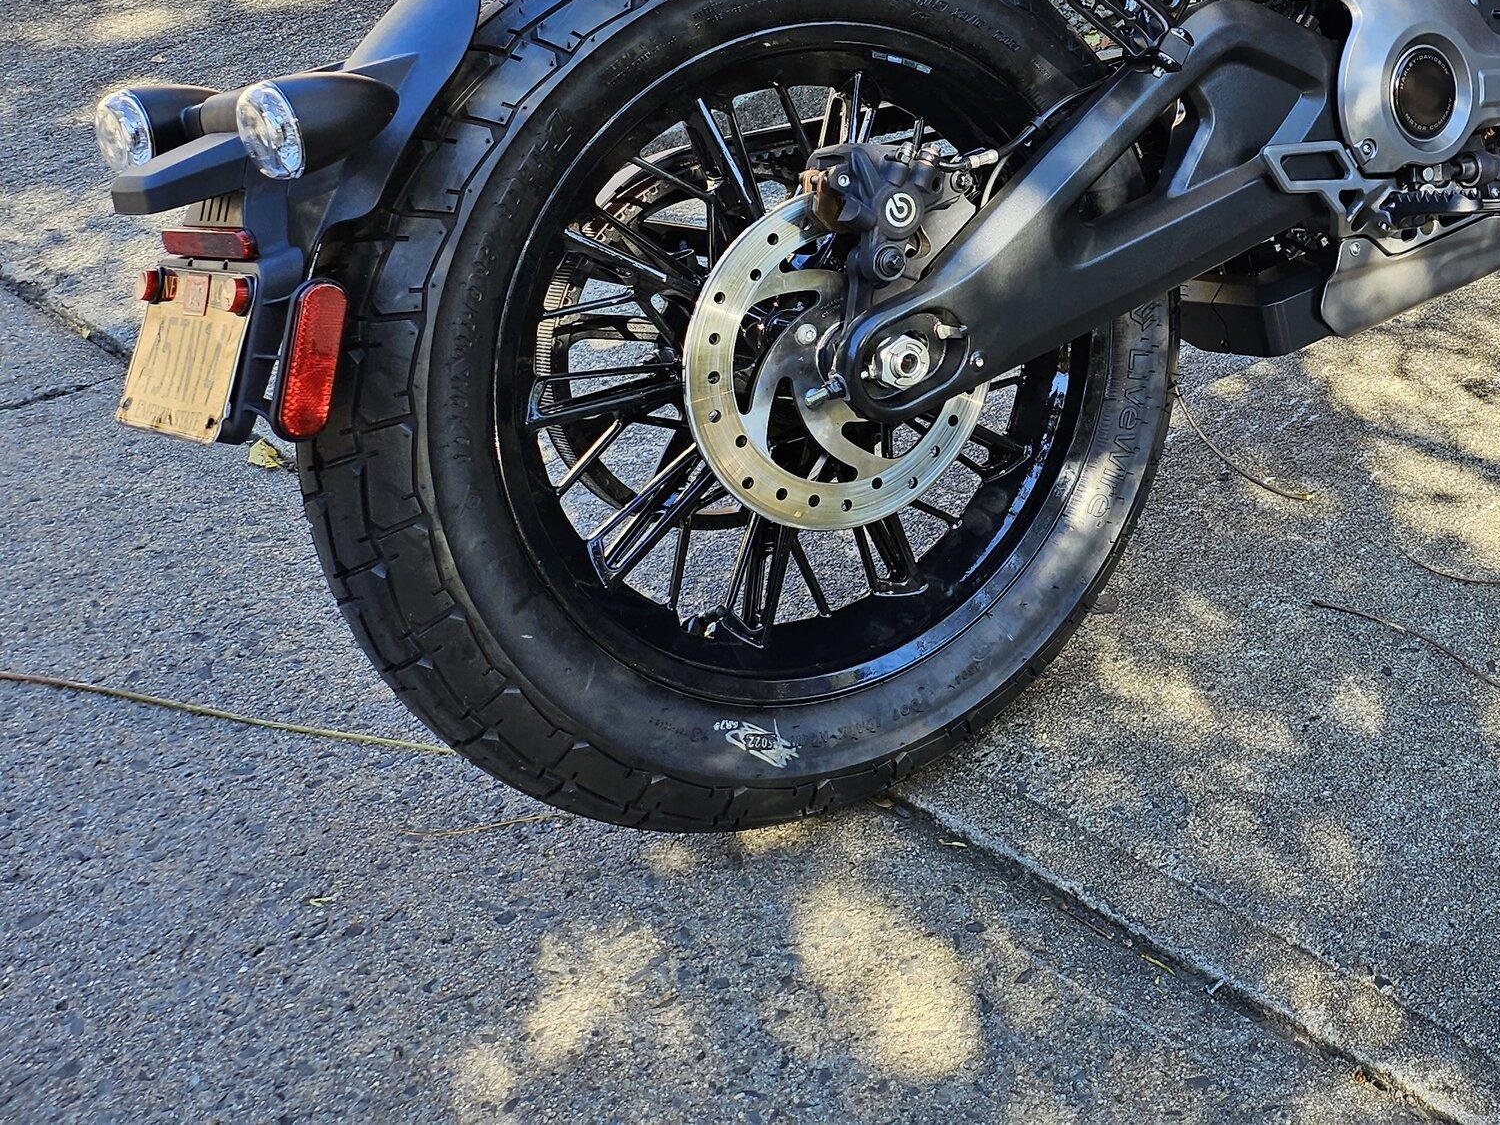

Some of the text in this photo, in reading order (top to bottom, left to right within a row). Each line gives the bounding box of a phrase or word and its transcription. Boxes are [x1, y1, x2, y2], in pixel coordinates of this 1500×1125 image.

[1405, 97, 1453, 132] MOTOR COMPANY
[1088, 347, 1150, 520] LiveWire
